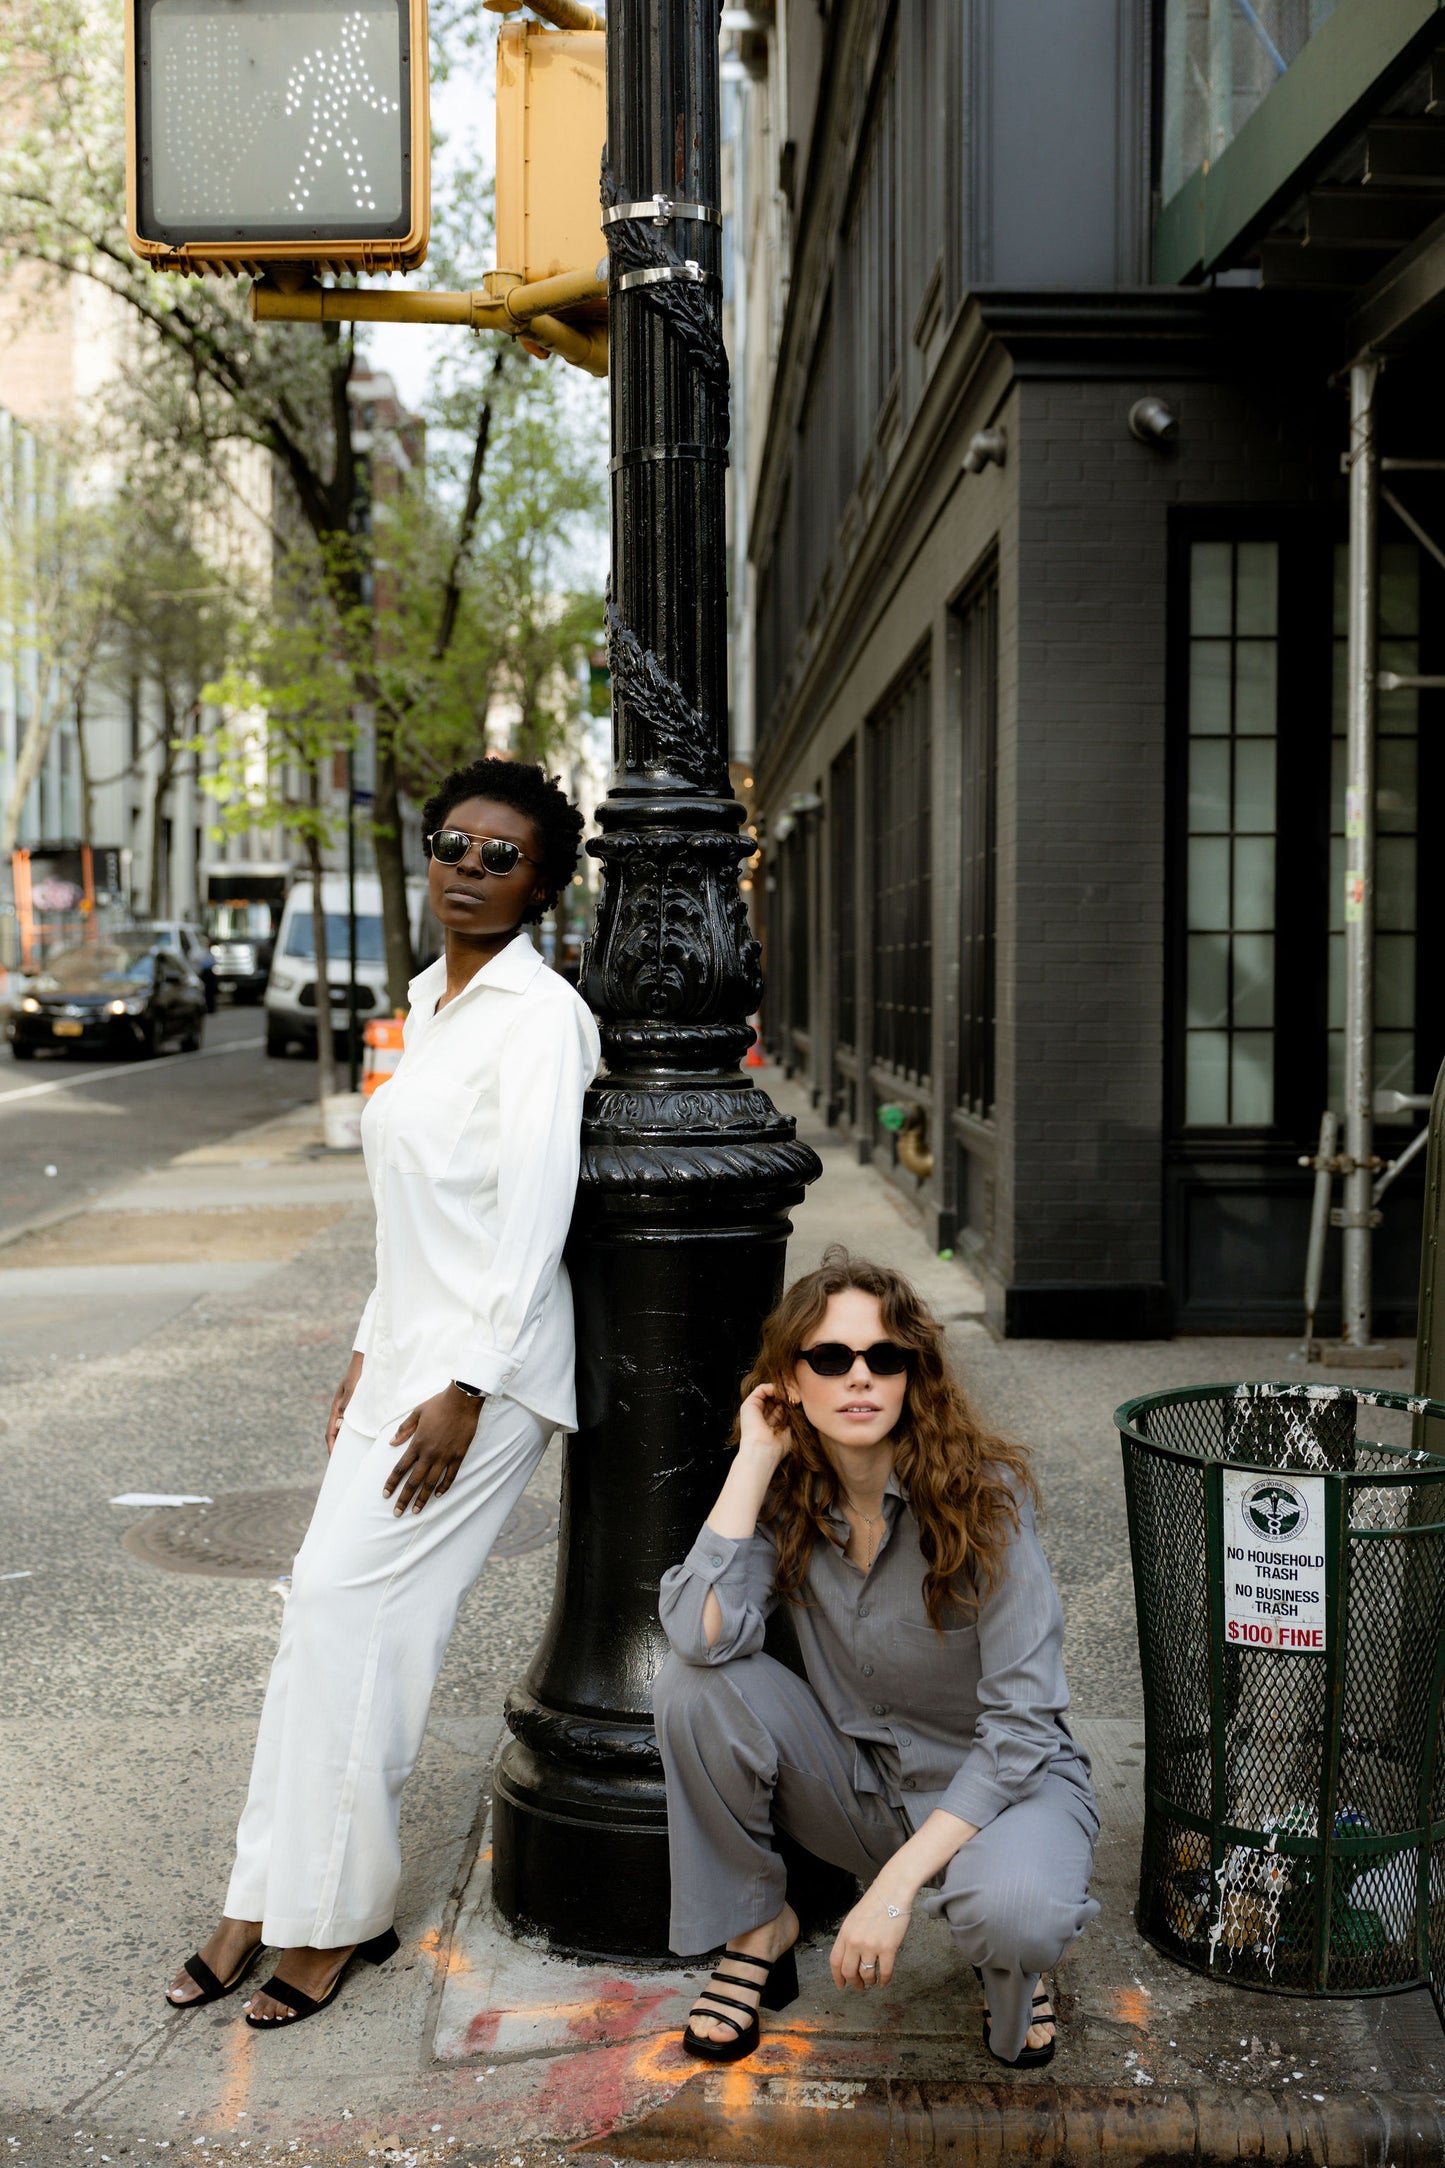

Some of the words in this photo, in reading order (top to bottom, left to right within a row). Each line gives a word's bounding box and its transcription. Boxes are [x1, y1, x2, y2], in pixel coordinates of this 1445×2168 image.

[1253, 1482, 1266, 1492] NEW
[1285, 1485, 1296, 1495] CITY
[1227, 1547, 1244, 1561] NO
[1248, 1550, 1324, 1568] HOUSEHOLD
[1255, 1565, 1298, 1581] TRASH
[1235, 1584, 1252, 1597] NO
[1256, 1587, 1319, 1603] BUSINESS
[1255, 1601, 1298, 1616] TRASH
[1228, 1620, 1272, 1644] $100
[1279, 1628, 1323, 1647] FINE
